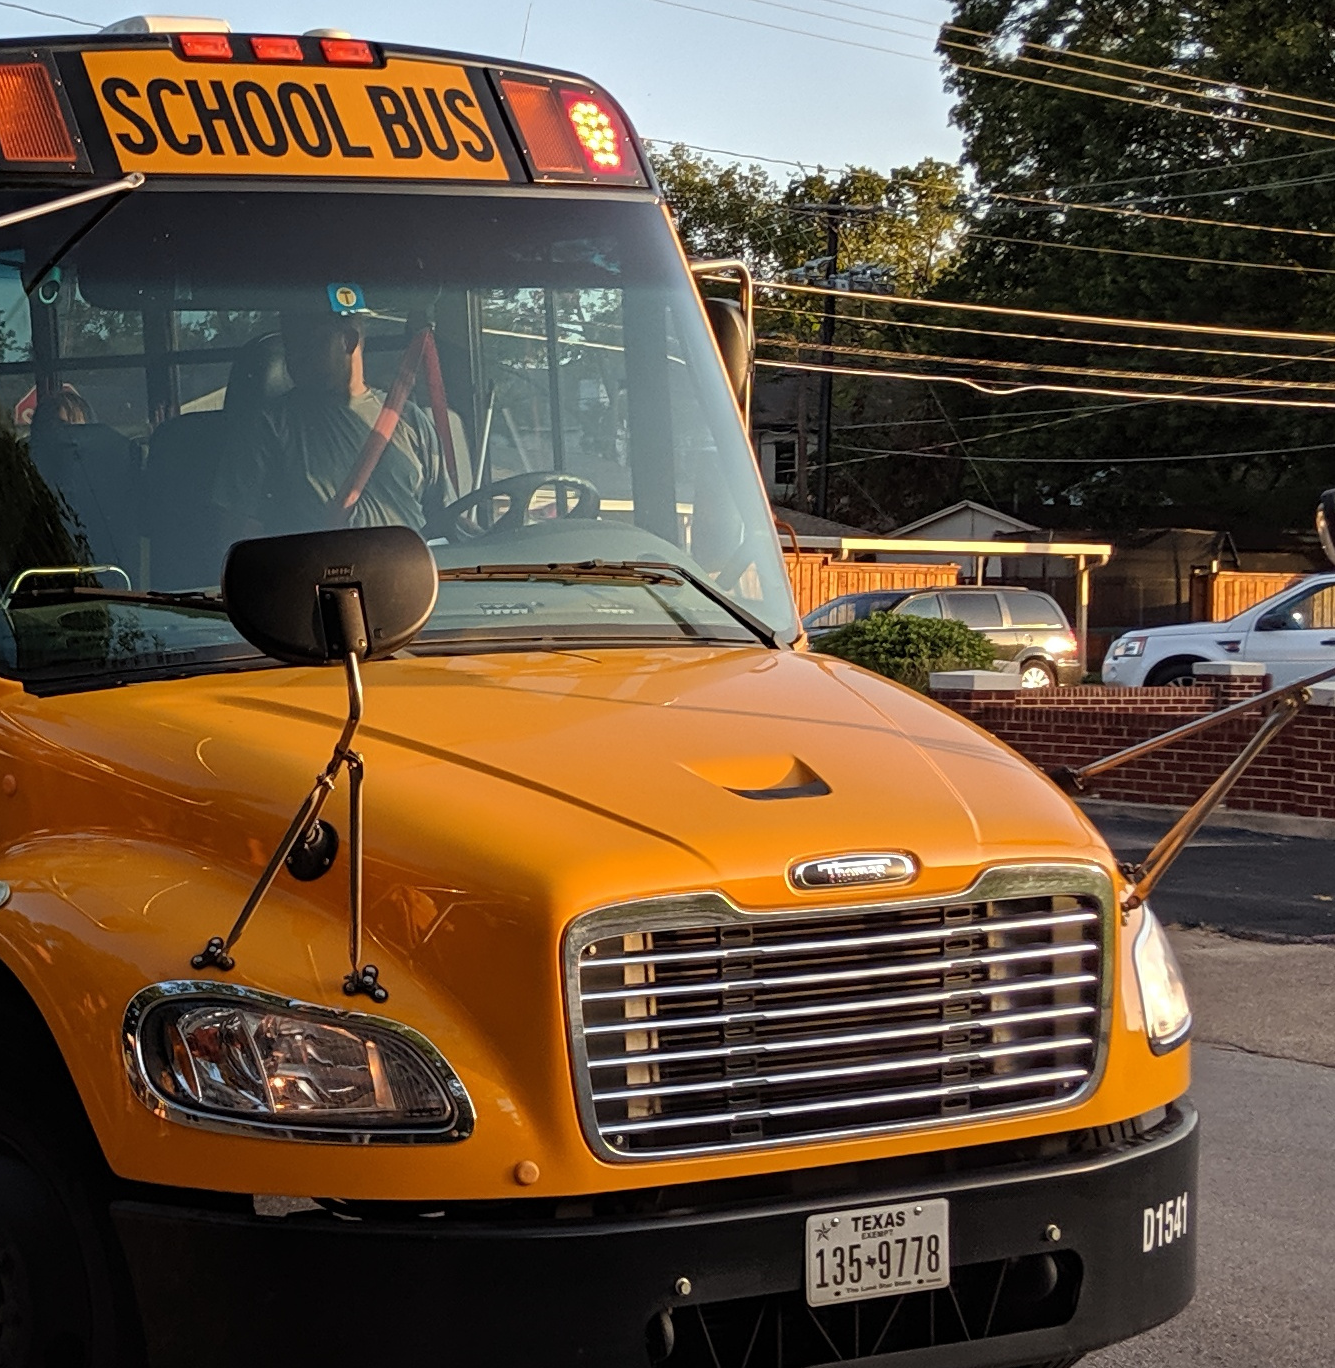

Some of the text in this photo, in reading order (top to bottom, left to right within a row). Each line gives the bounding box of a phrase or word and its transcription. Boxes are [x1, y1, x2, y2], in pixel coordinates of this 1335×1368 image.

[100, 77, 494, 162] SCHOOL BUS
[339, 290, 352, 305] T
[817, 859, 892, 876] Thomas
[851, 1211, 906, 1232] TEXAS
[1143, 1191, 1188, 1253] D1541
[861, 1229, 894, 1240] EXEMPT
